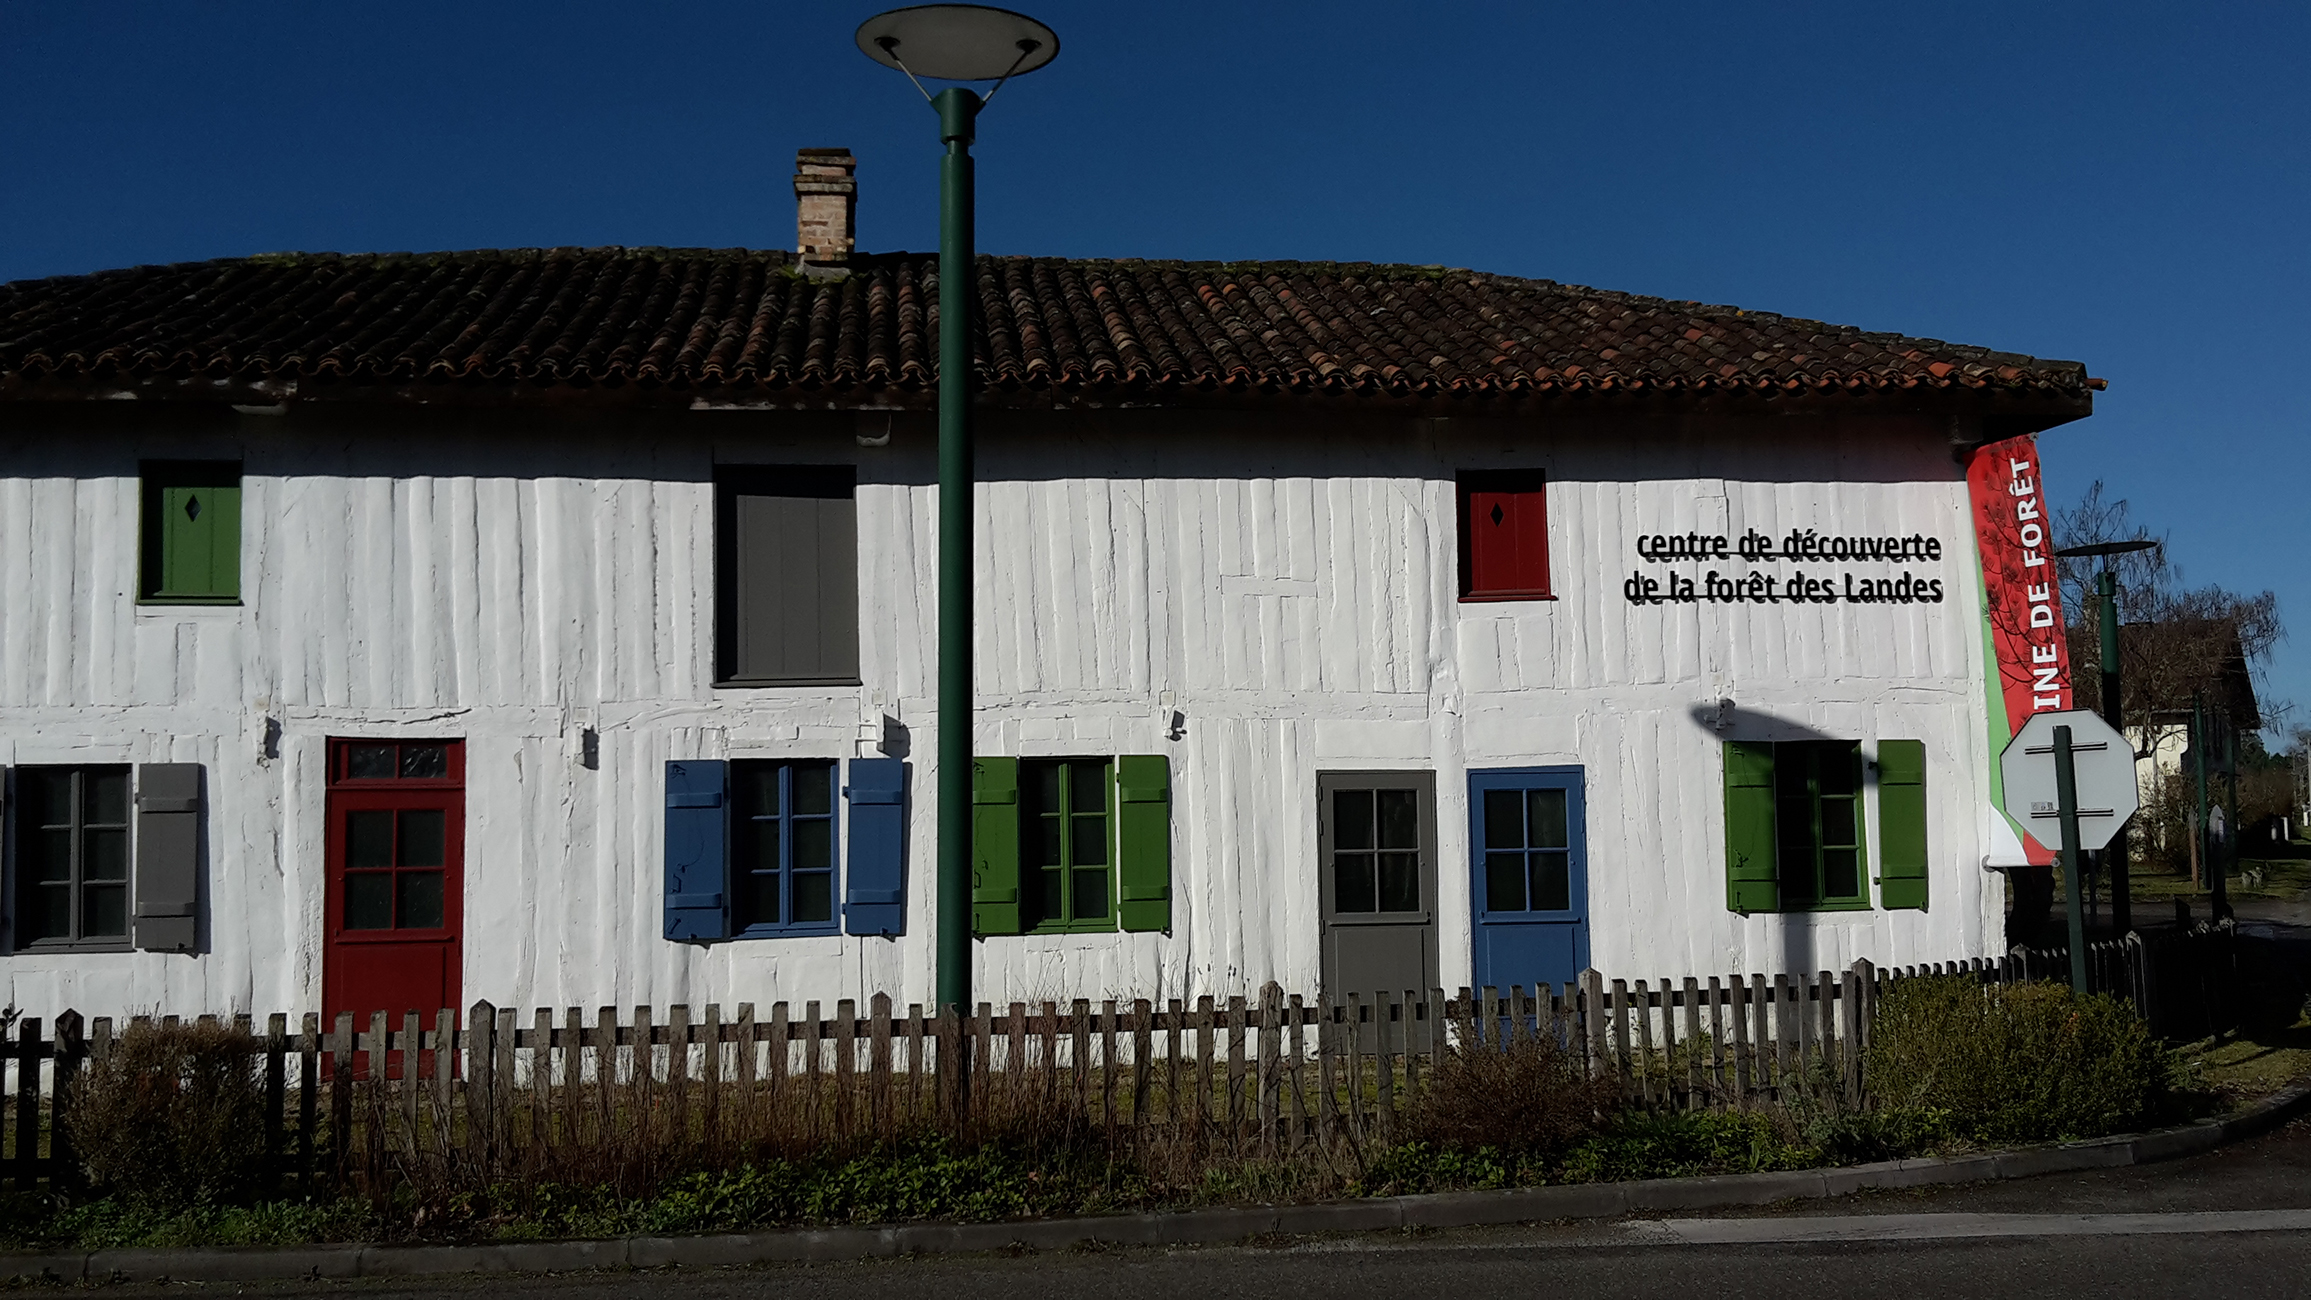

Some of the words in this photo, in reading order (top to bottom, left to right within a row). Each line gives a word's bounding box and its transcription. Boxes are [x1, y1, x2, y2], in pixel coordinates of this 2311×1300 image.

[2009, 457, 2046, 568] FORÊT
[1637, 530, 1728, 558] centre
[1738, 528, 1773, 558] de
[1783, 528, 1942, 559] découverte
[1624, 571, 1659, 602] de
[1669, 571, 1695, 602] la
[1705, 570, 1777, 602] forêt
[1786, 571, 1835, 602] des
[1845, 571, 1943, 602] Landes
[2028, 581, 2053, 628] DE
